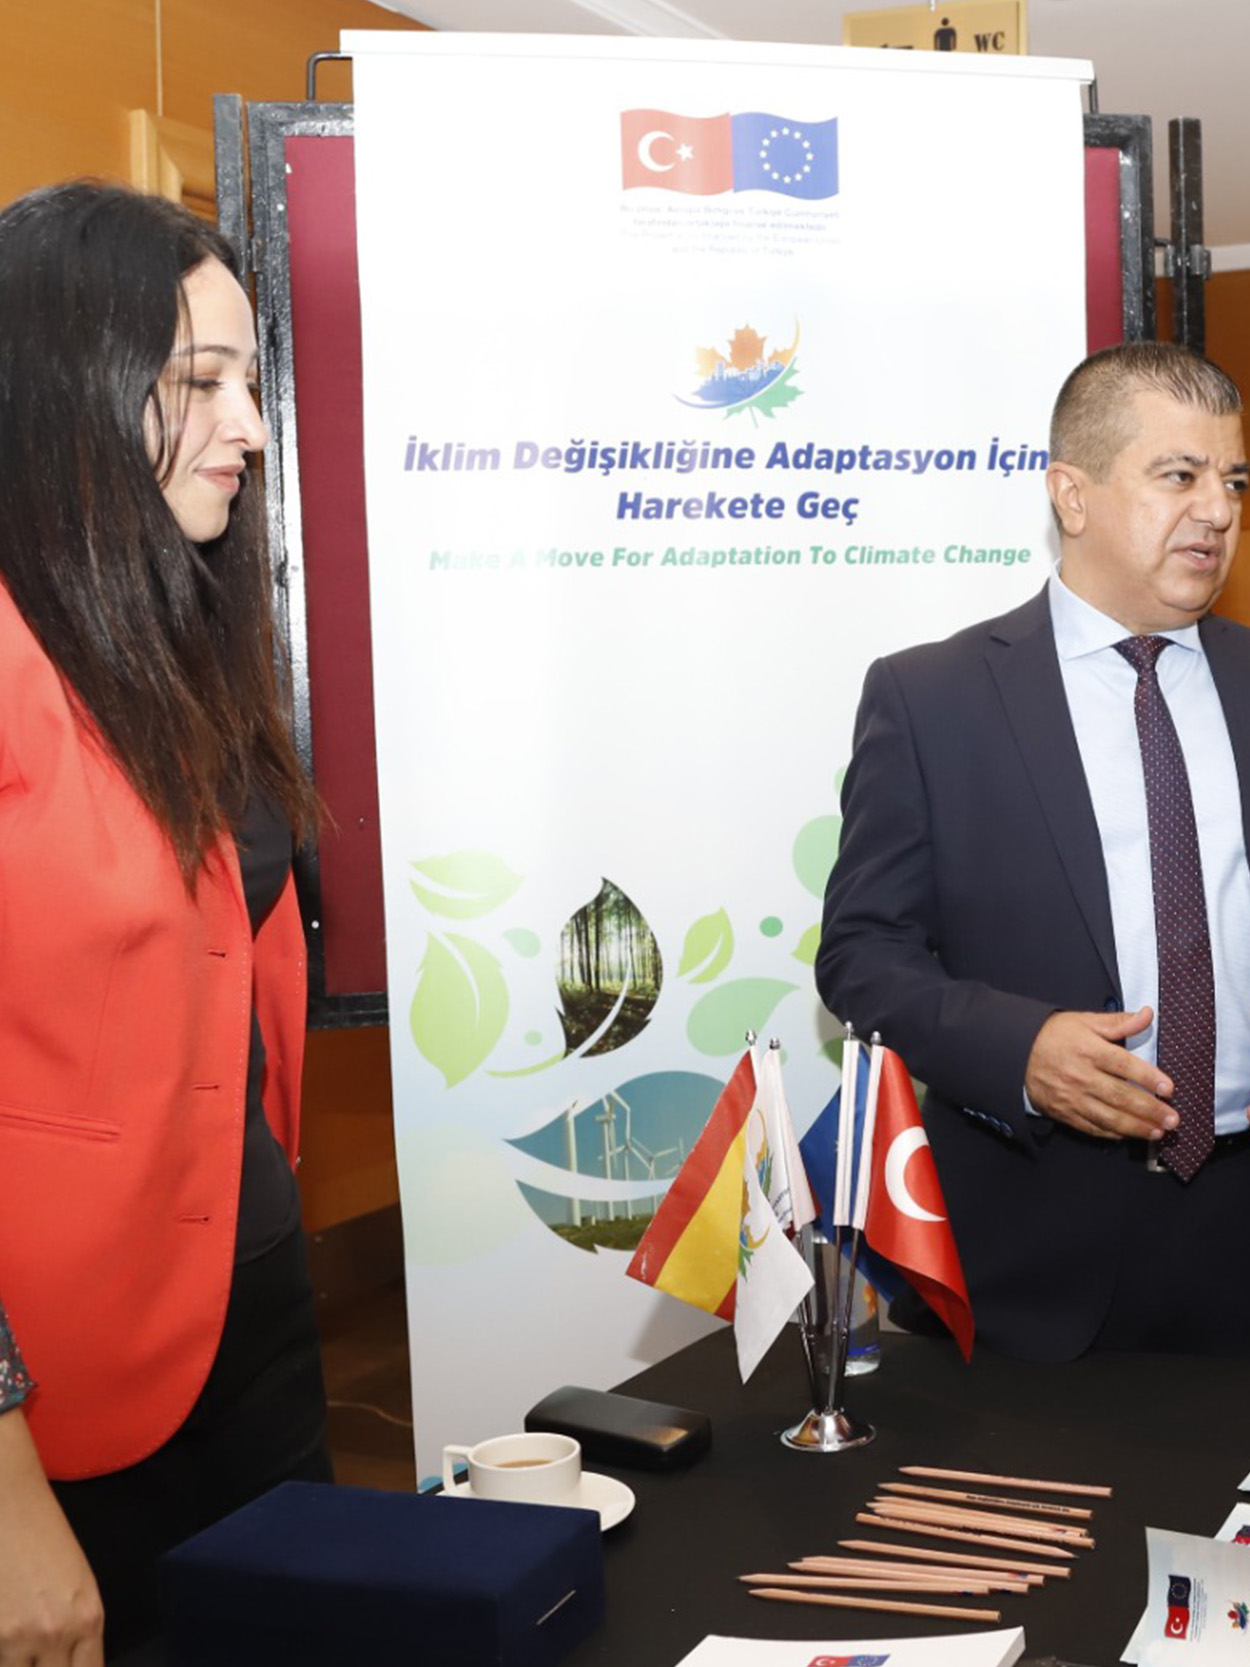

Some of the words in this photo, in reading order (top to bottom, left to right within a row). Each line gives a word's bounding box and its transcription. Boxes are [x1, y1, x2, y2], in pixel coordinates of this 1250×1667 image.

[973, 31, 1005, 52] WC
[404, 435, 501, 472] İklim
[513, 438, 757, 477] Değişikliğine
[764, 440, 978, 476] Adaptasyon
[986, 436, 1049, 478] İçin
[616, 490, 786, 521] Harekete
[795, 490, 861, 526] Geç
[429, 549, 501, 571] Make
[510, 548, 526, 569] A
[535, 548, 605, 568] Move
[611, 546, 655, 568] For
[659, 545, 802, 568] Adaptation
[808, 545, 838, 566] To
[843, 544, 937, 566] Climate
[943, 543, 1032, 568] Change
